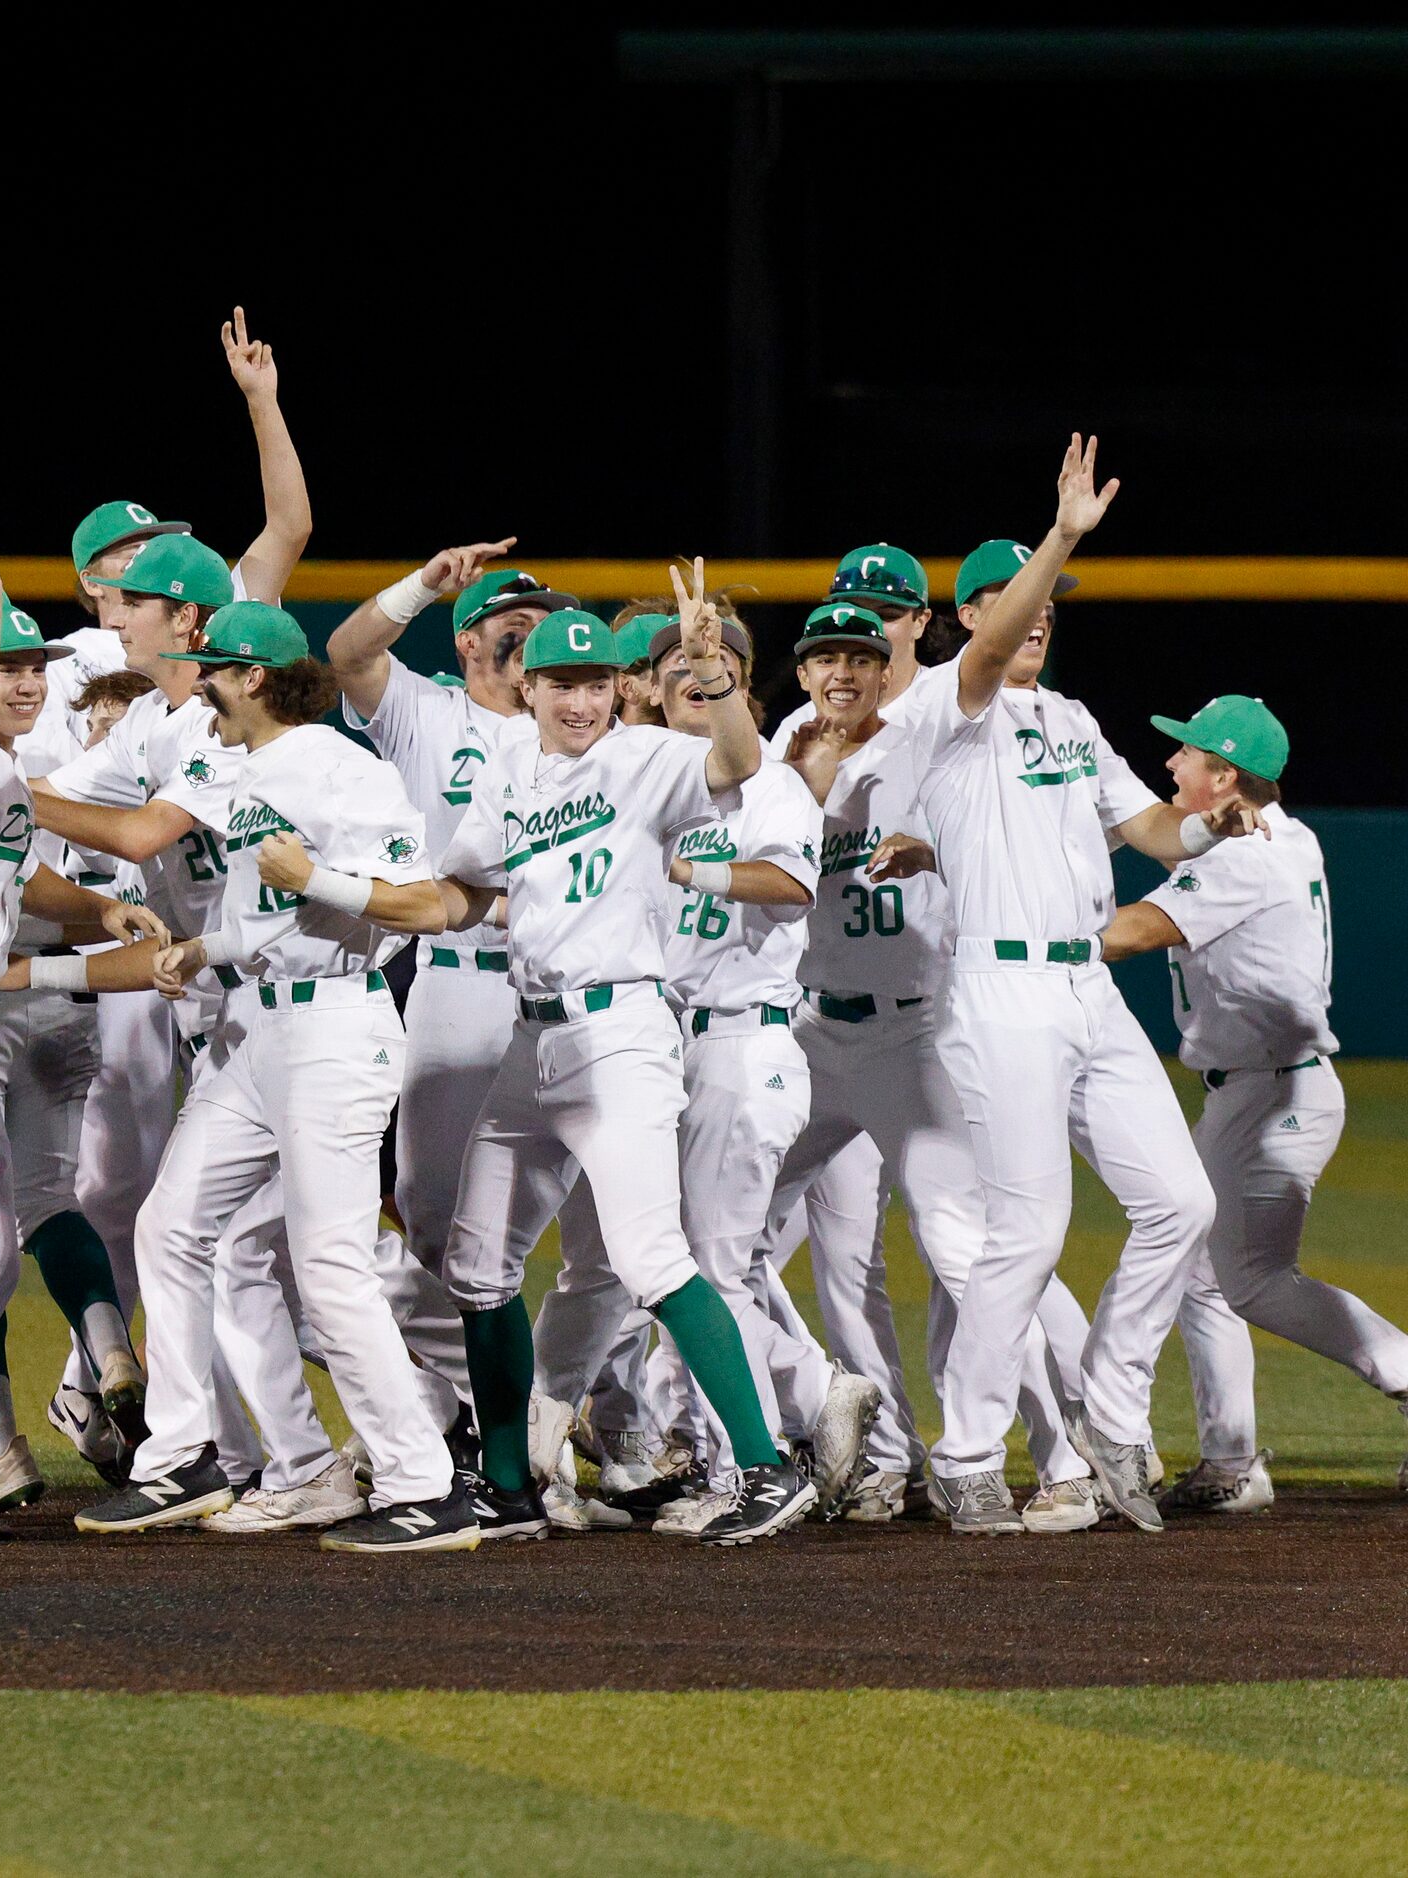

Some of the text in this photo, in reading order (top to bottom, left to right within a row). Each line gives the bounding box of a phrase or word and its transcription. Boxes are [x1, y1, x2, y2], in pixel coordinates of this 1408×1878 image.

[126, 503, 153, 525] C
[10, 610, 36, 636] C
[568, 623, 592, 652] C
[564, 848, 613, 903] 10
[841, 884, 905, 938] 30
[765, 1081, 785, 1090] adidas
